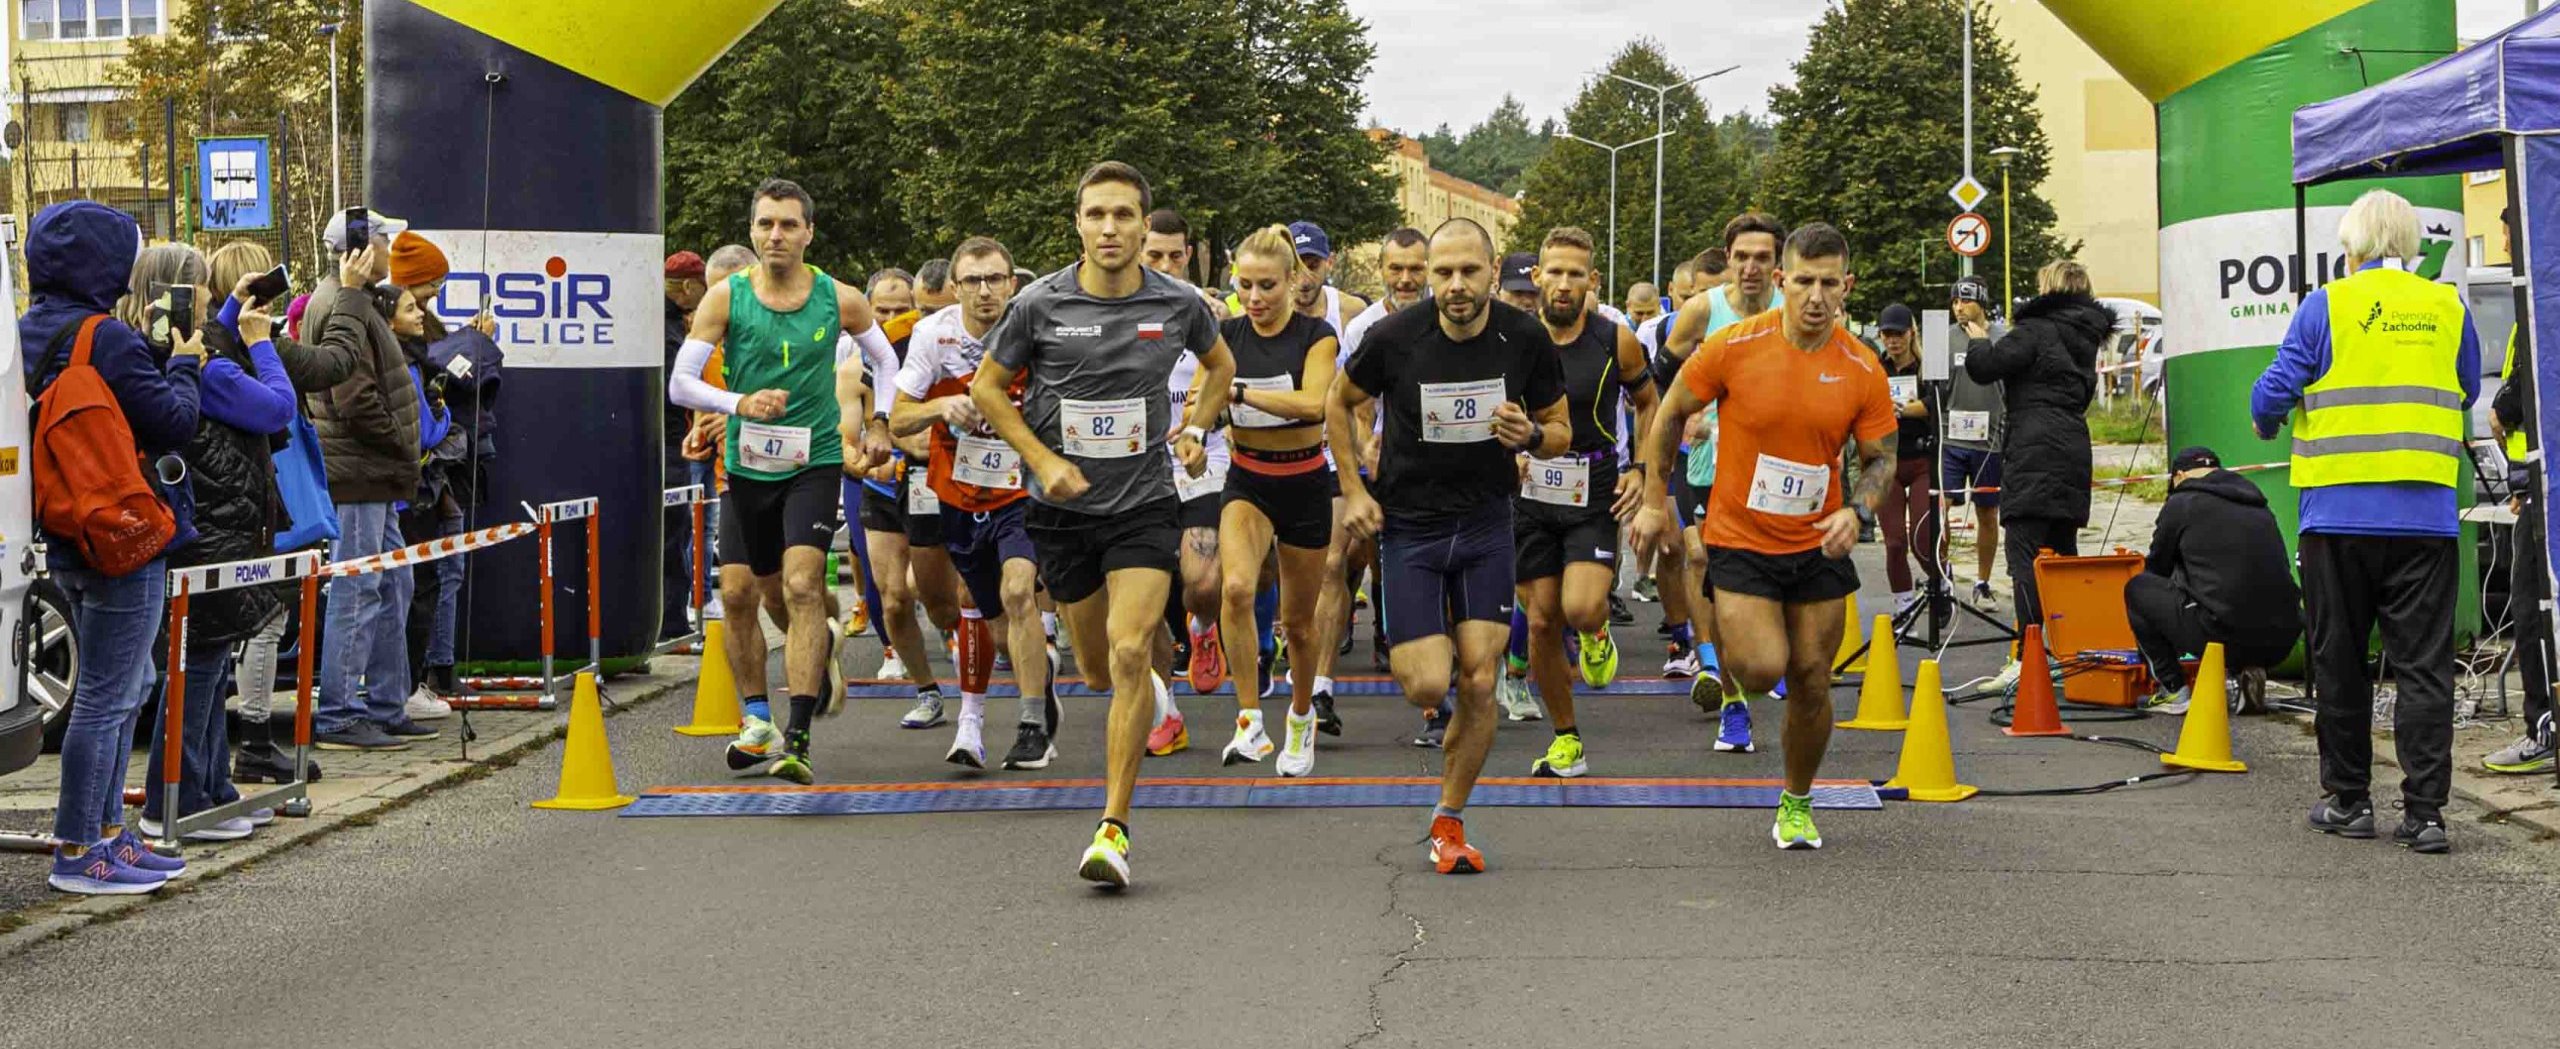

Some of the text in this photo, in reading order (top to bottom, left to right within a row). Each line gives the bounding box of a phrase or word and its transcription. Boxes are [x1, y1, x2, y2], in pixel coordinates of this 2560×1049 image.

[2231, 302, 2290, 318] GMINA
[443, 322, 614, 344] LICE
[2382, 321, 2437, 332] Zachodnie
[1454, 398, 1476, 419] 28
[1093, 416, 1114, 436] 82
[1963, 418, 1974, 429] 34
[764, 438, 783, 456] 47
[982, 452, 1001, 469] 43
[1544, 469, 1562, 486] 99
[1782, 475, 1804, 496] 91
[235, 563, 271, 583] POLANIK
